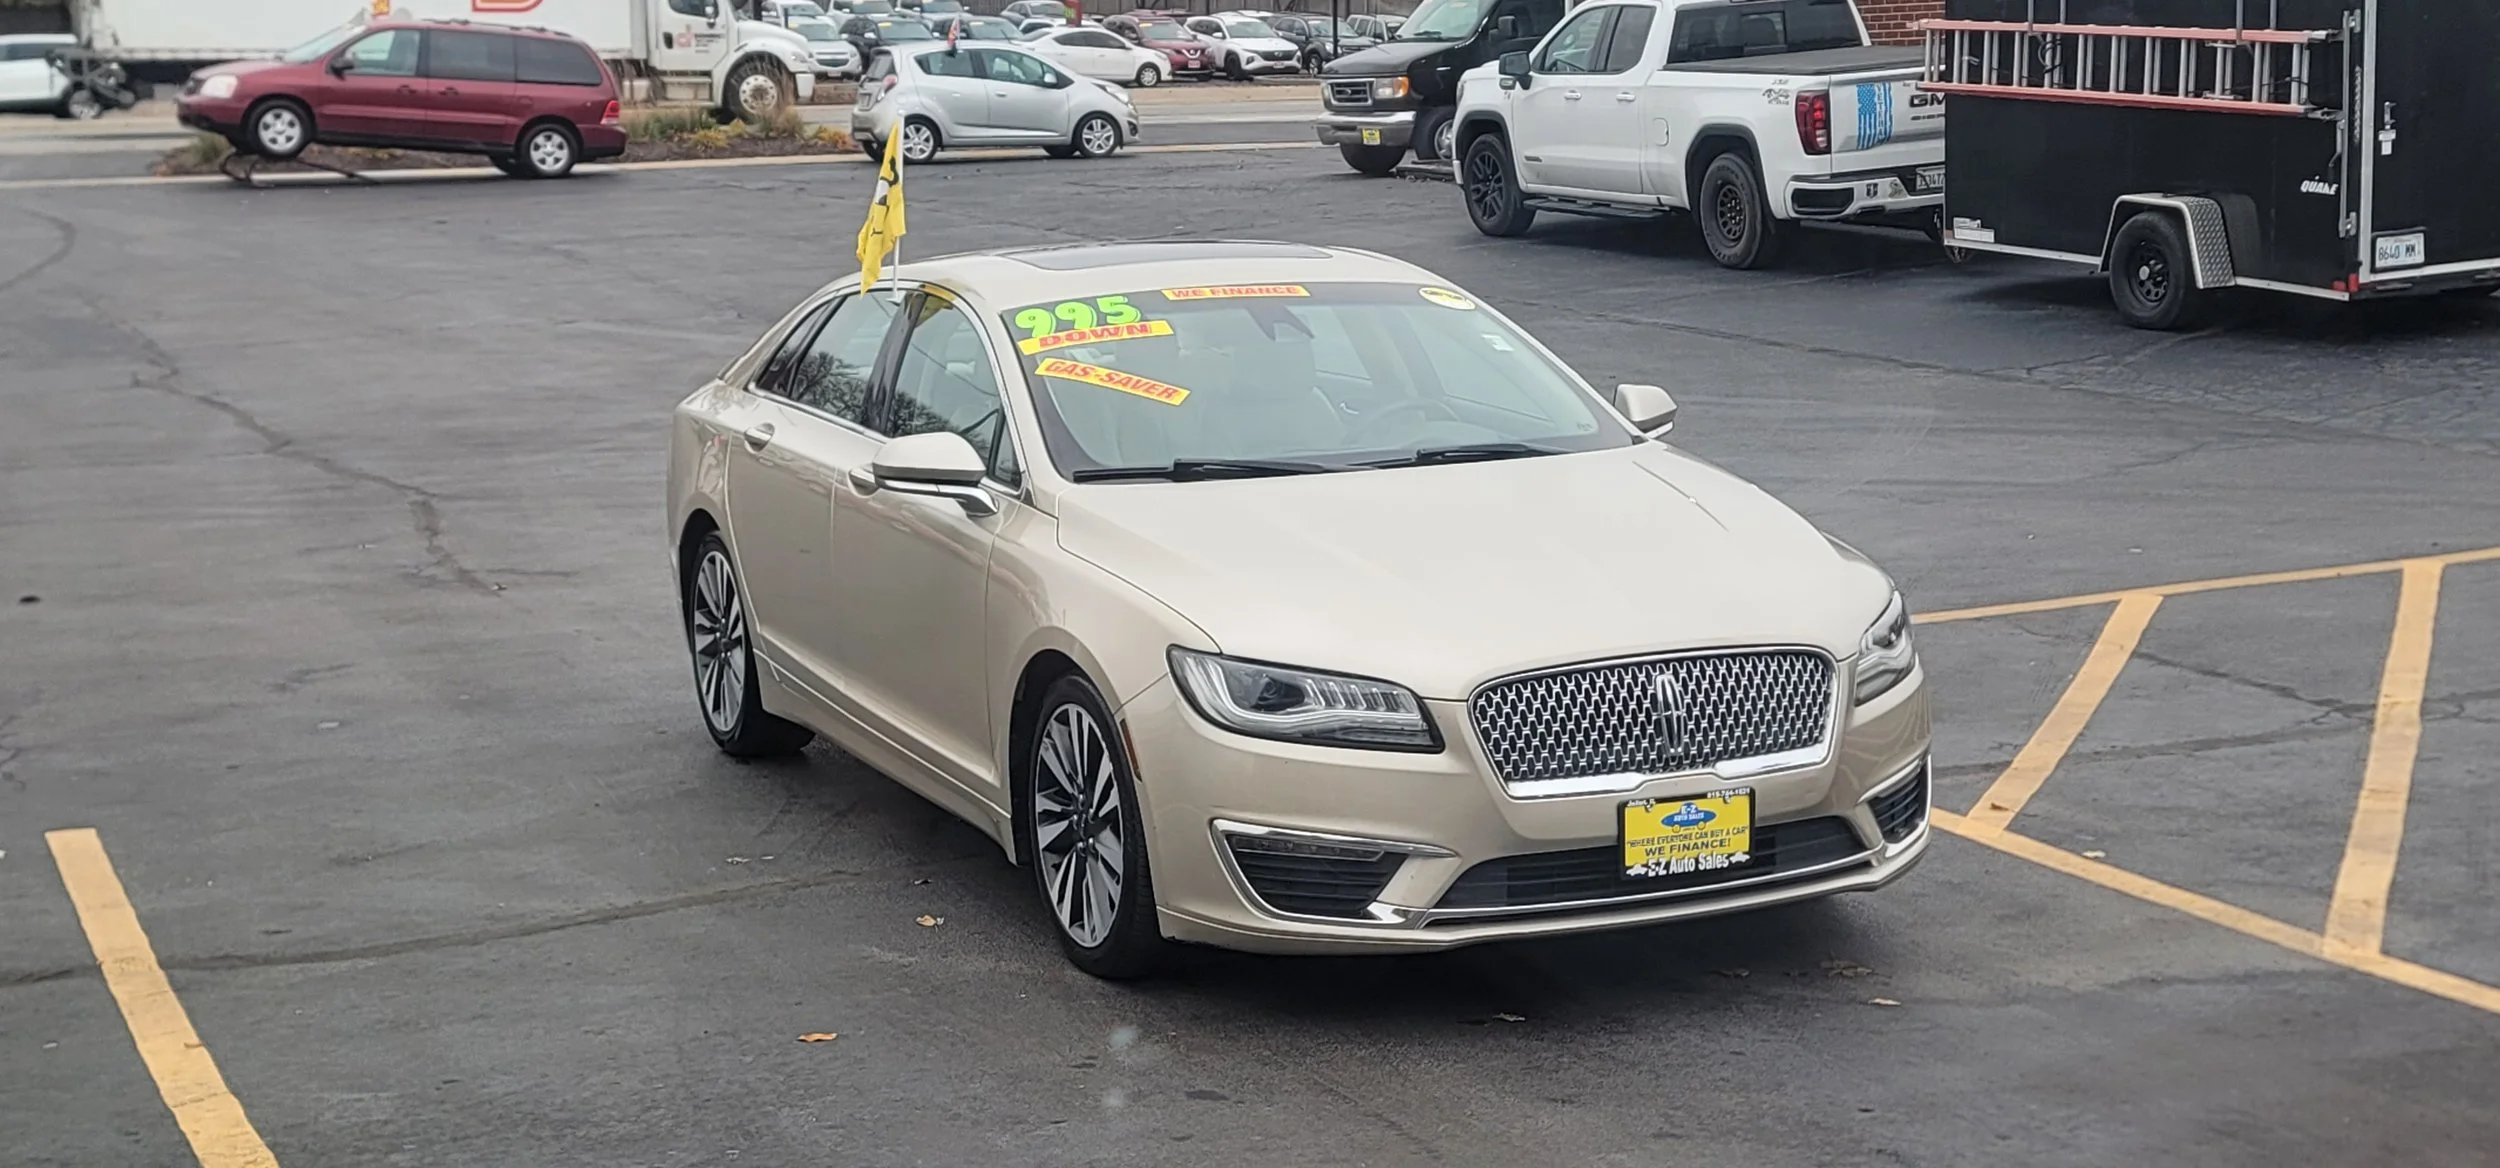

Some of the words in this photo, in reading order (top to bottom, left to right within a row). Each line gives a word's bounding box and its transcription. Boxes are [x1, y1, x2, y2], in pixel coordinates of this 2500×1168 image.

[1909, 93, 1946, 108] GM
[1171, 290, 1203, 298] WE
[1210, 286, 1298, 297] FINANCE
[1015, 296, 1142, 338] 995
[1039, 323, 1149, 348] DOWN
[1045, 361, 1179, 399] GAS-SAVER
[1681, 804, 1697, 814] E-Z
[1645, 845, 1665, 857] WE
[1669, 838, 1731, 853] FINANCE!
[1668, 855, 1695, 875] Auto
[1698, 851, 1729, 871] Sales
